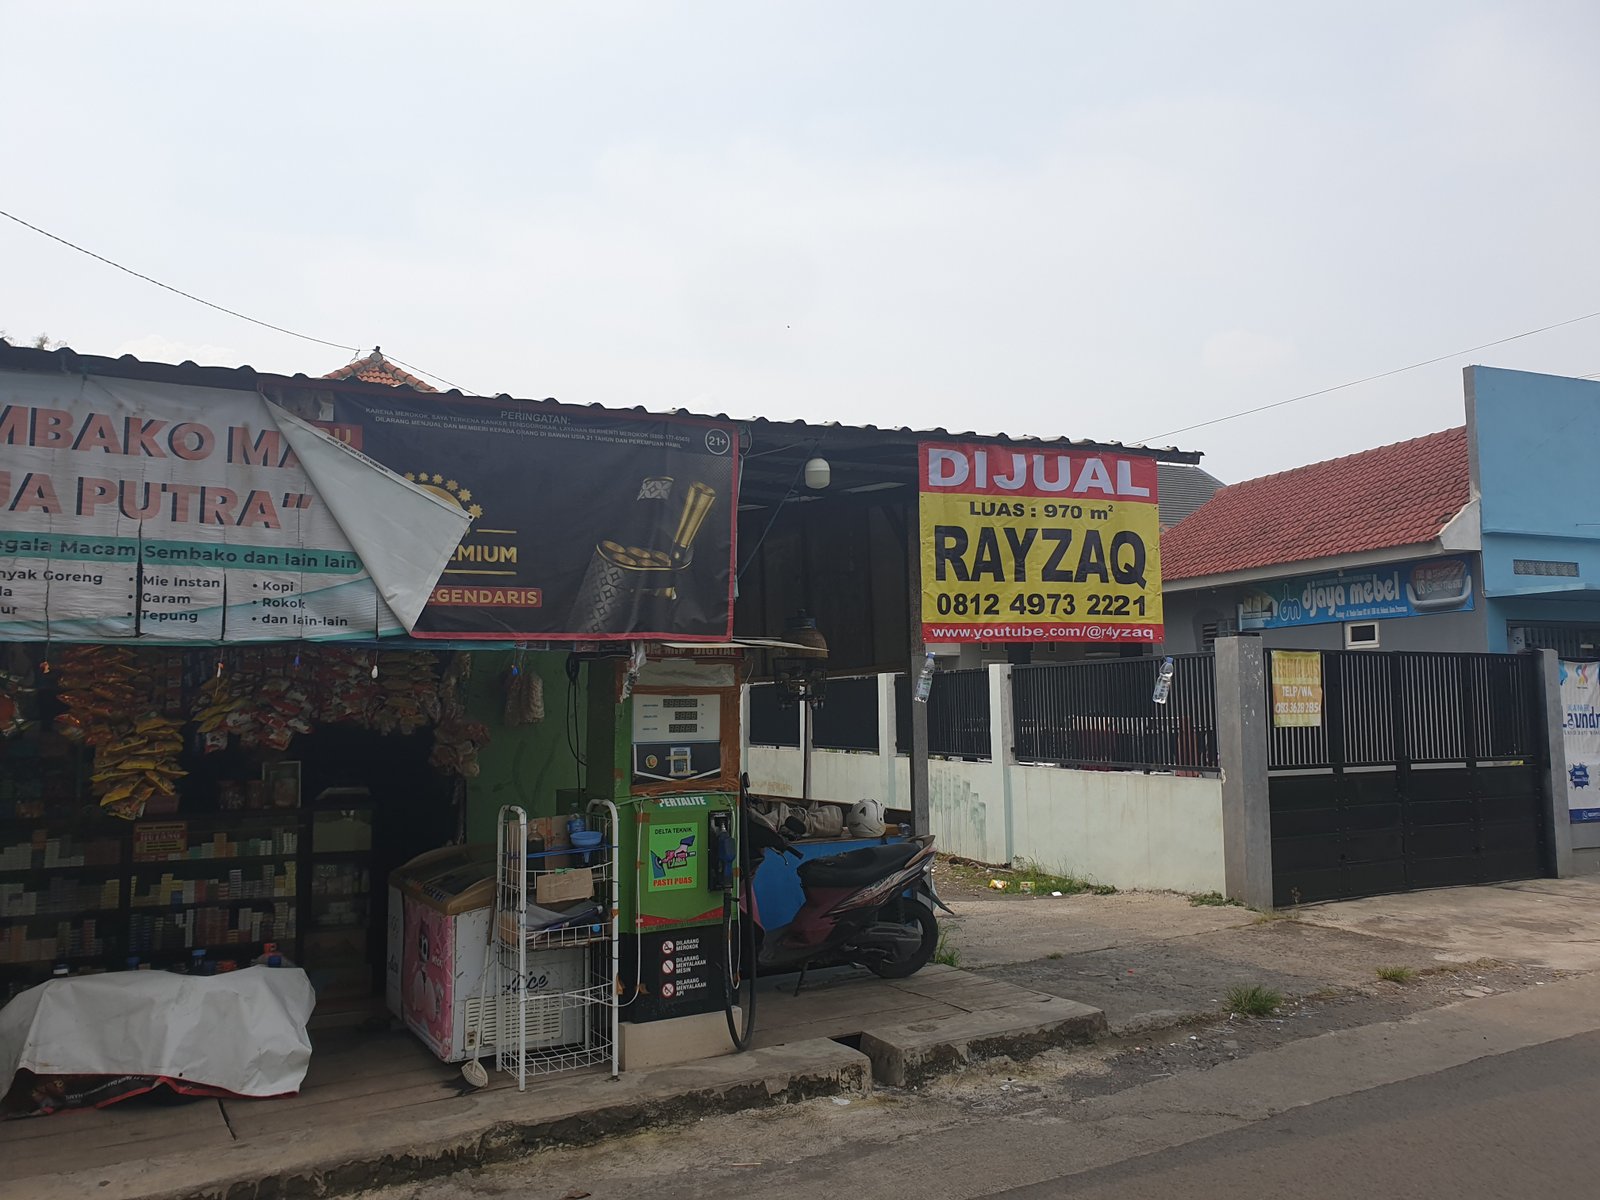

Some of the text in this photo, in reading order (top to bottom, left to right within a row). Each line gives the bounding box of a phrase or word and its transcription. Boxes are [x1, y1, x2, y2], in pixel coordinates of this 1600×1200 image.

[365, 407, 394, 416] KARENA
[450, 416, 480, 425] TERKENA
[481, 419, 508, 427] KANKER
[501, 410, 571, 425] PERINGATAN:
[375, 416, 410, 425] DILARANG
[594, 435, 614, 443] TAHUN
[628, 438, 664, 447] PEREMPUAN
[708, 436, 726, 446] 21+
[928, 448, 1150, 497] DIJUAL
[969, 501, 1025, 517] LUAS
[1044, 504, 1082, 519] 970
[0, 538, 357, 569] gala Macam Sembako dan lain lain
[450, 545, 518, 564] MIUM
[934, 525, 1147, 590] RAYZAQ
[43, 570, 103, 585] Goreng
[143, 576, 220, 588] Mie Instan
[262, 581, 295, 593] Kopi
[142, 592, 191, 604] Garam
[1302, 581, 1345, 618] djaya
[1350, 571, 1400, 604] mebel
[262, 597, 306, 609] Rokok
[937, 593, 1146, 617] 0812 4973 2221
[141, 610, 198, 623] Tepung
[261, 614, 348, 627] dan lain-lain
[931, 624, 1154, 641] www.youtube.com/@r4yzaq
[660, 796, 707, 807] PERTALITE
[653, 878, 673, 888] PASTI
[676, 938, 700, 946] DILARANG
[676, 955, 700, 963] DILARANG
[676, 978, 700, 986] DILARANG
